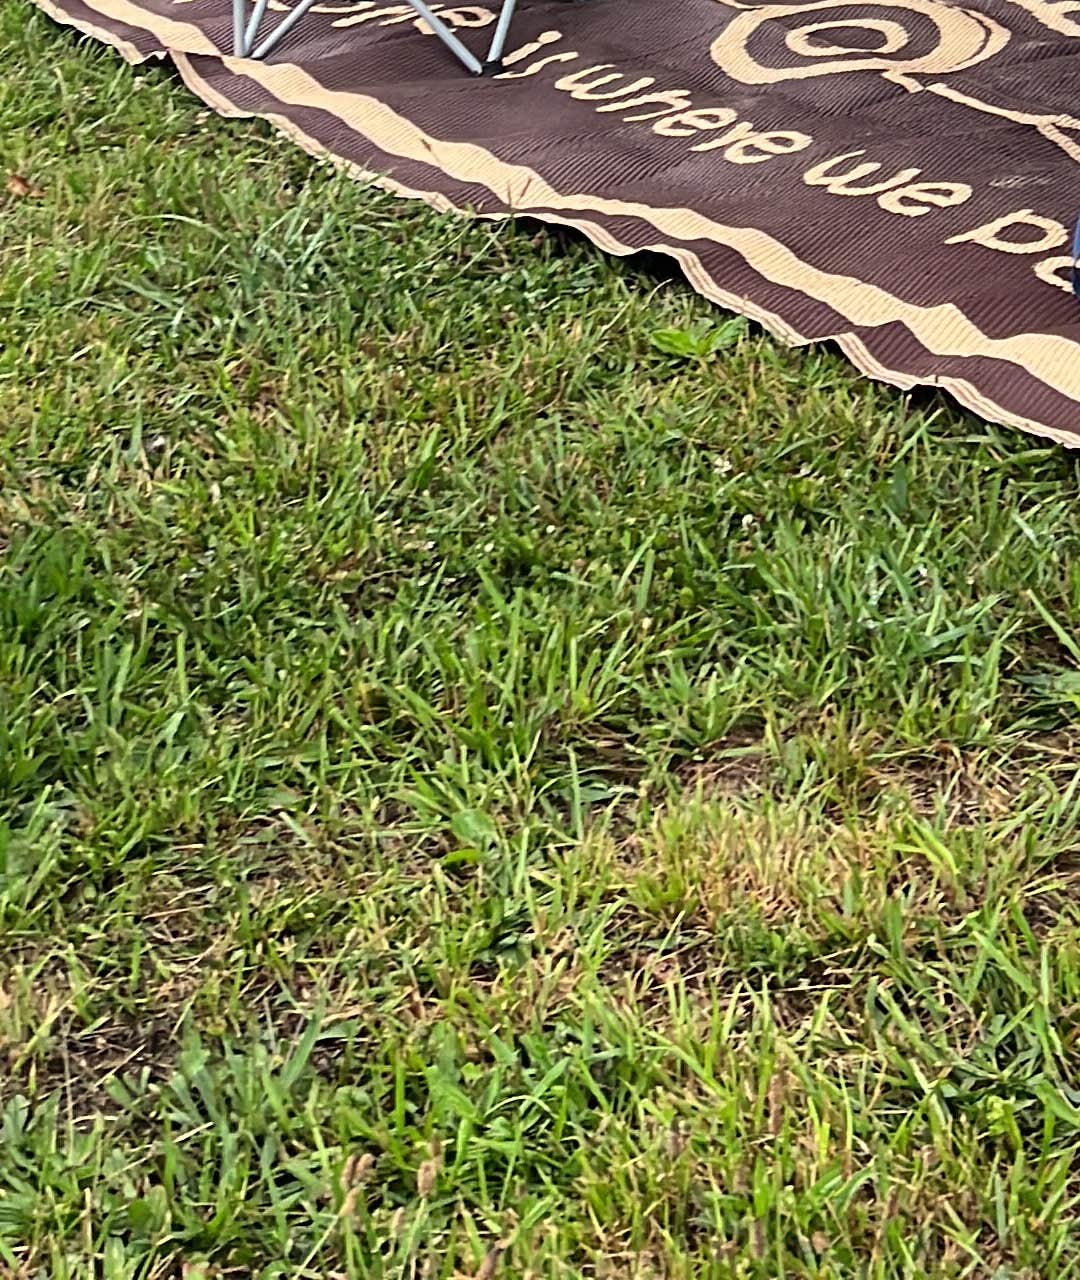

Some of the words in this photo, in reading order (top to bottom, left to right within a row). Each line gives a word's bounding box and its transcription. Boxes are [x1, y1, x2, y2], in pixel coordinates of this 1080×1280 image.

[493, 29, 579, 80] is
[554, 63, 813, 165] where
[802, 149, 974, 217] we
